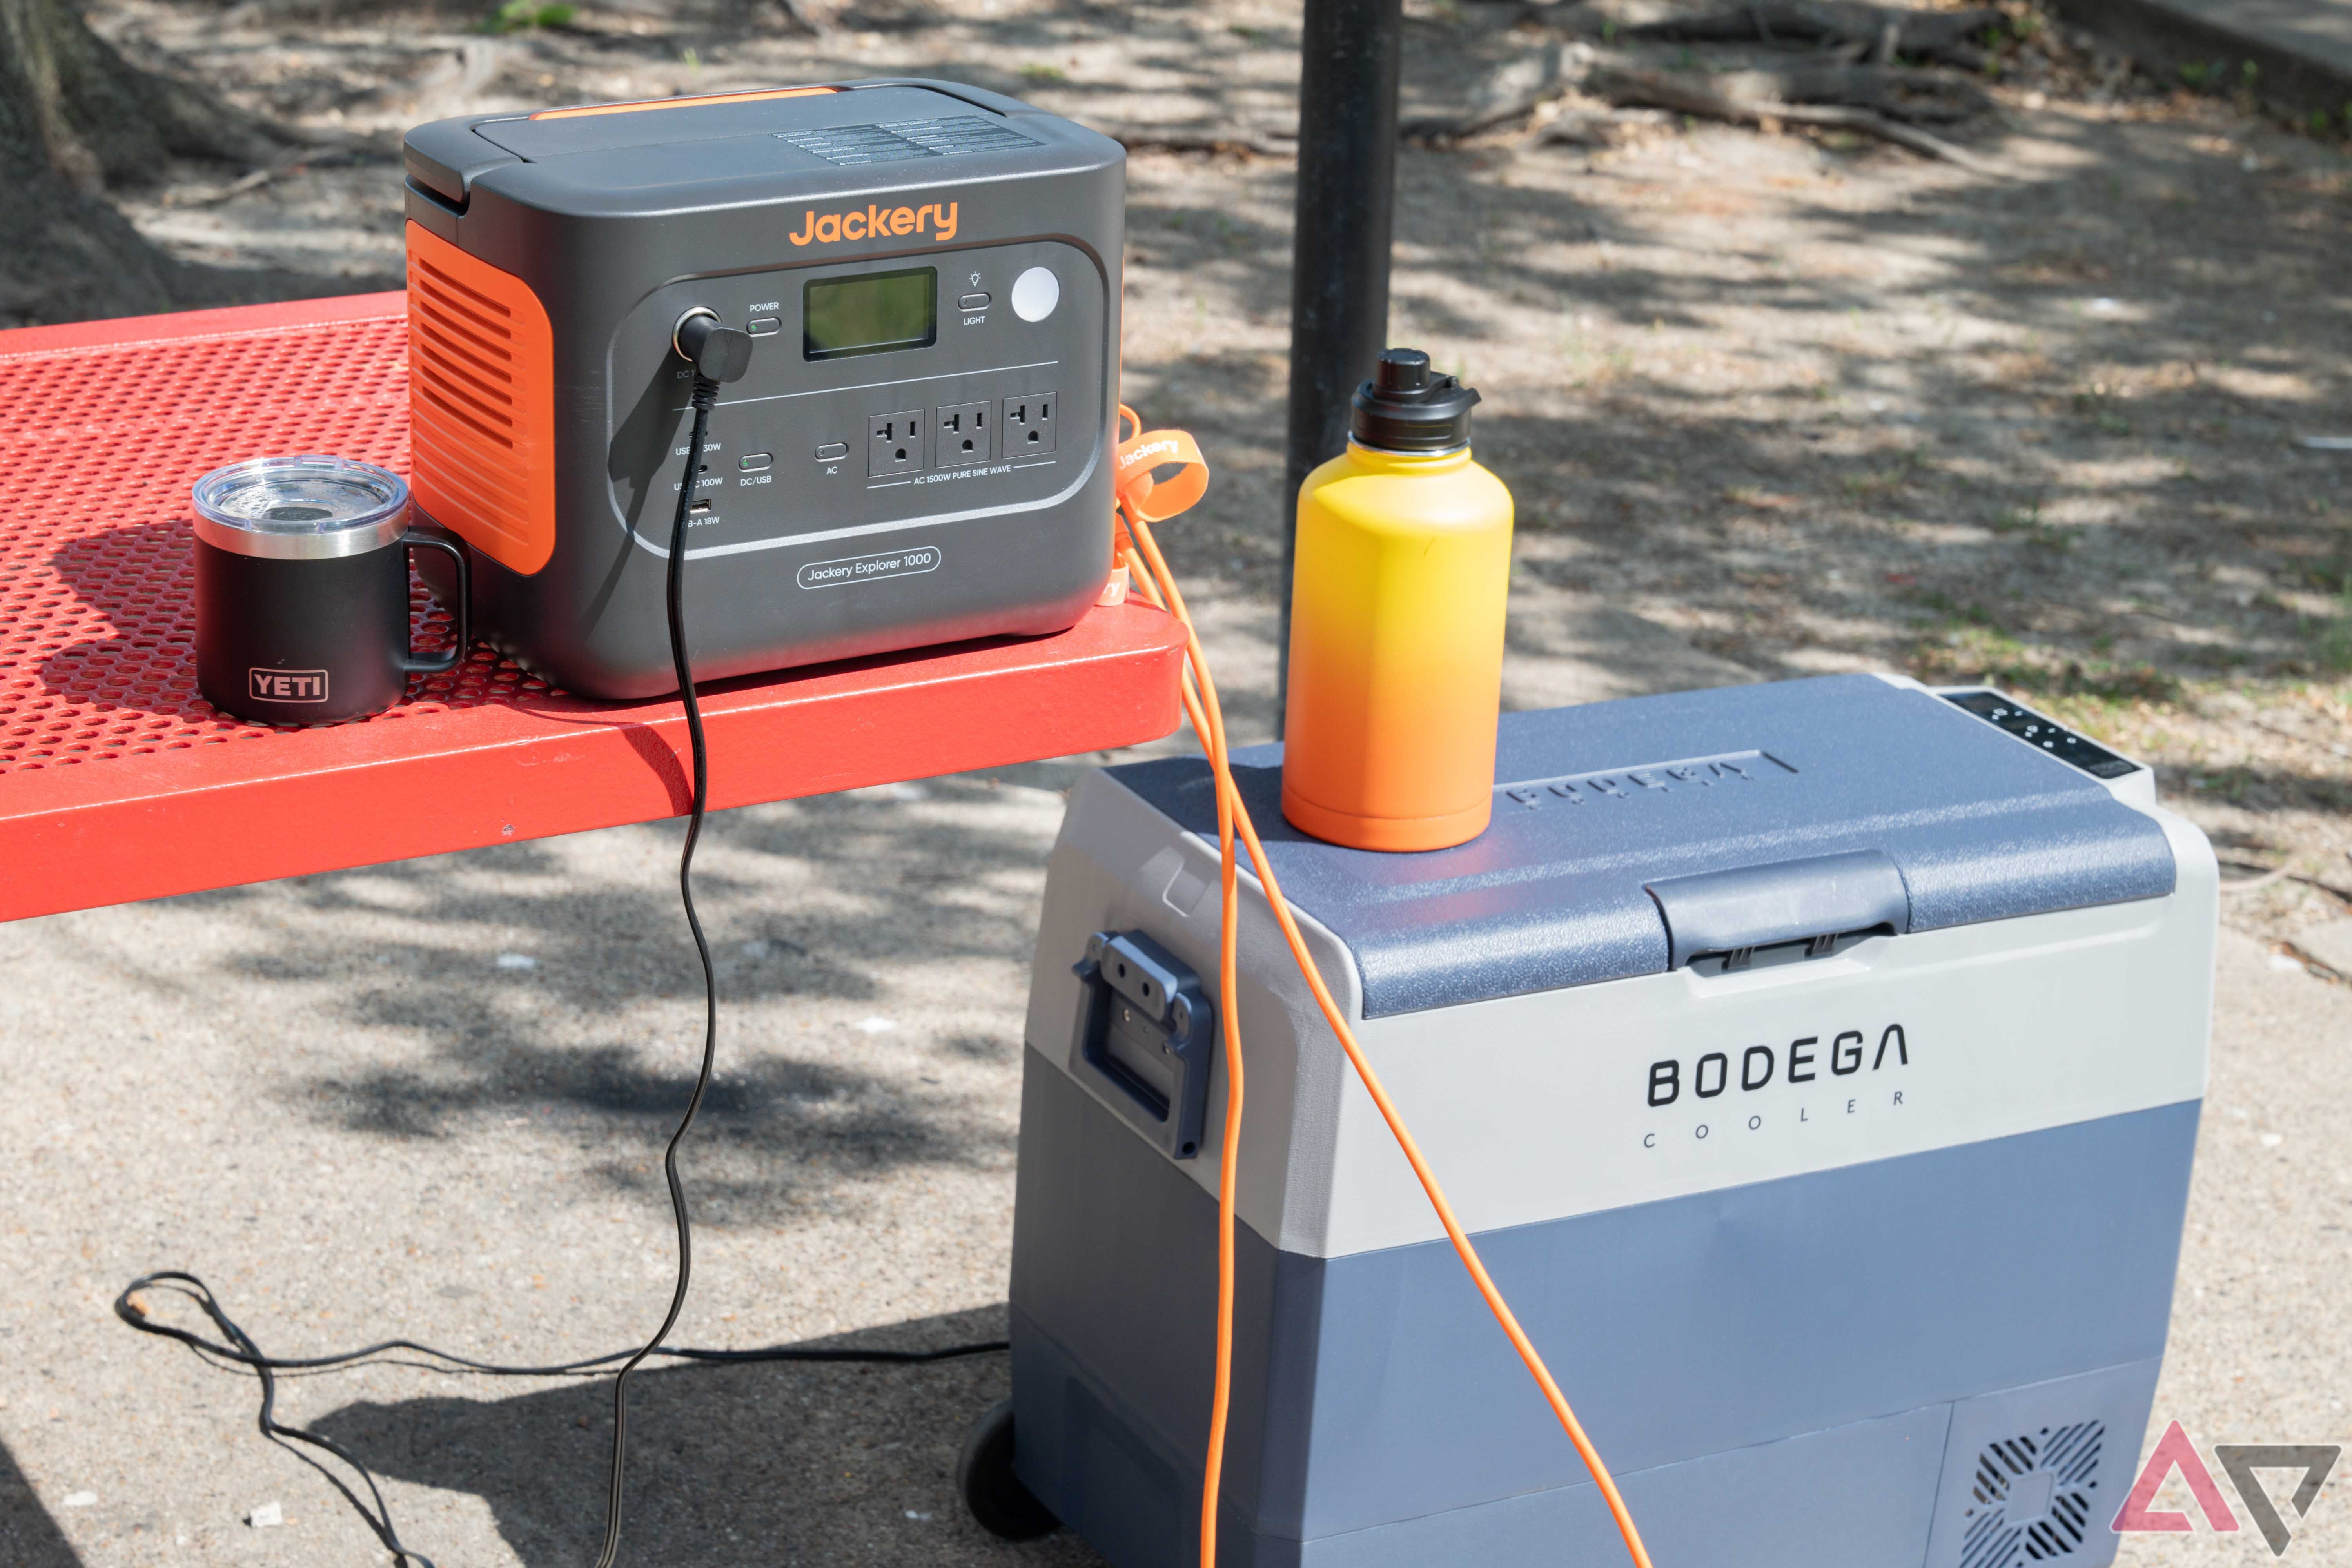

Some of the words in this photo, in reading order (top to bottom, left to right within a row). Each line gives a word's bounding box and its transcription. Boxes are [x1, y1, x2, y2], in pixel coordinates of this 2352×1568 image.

[789, 202, 958, 246] Jackery
[750, 301, 779, 312] POWER
[964, 316, 985, 326] LIGHT
[677, 370, 690, 379] DC
[703, 443, 722, 452] 30W
[1119, 440, 1179, 470] Jackery
[826, 466, 838, 475] AC
[913, 477, 926, 485] AC
[926, 473, 951, 483] 1500W
[952, 470, 971, 480] PURE
[972, 468, 988, 477] SINE
[989, 465, 1011, 475] WAVE
[701, 477, 724, 487] 100W
[740, 475, 772, 486] DC/USB
[704, 516, 720, 525] 18W
[808, 566, 853, 581] Jackery
[855, 559, 901, 574] Explorer
[903, 552, 931, 566] 1000
[253, 673, 321, 697] YETI
[1647, 1024, 1909, 1107] BODEGA
[1643, 1091, 1904, 1148] COOLER
